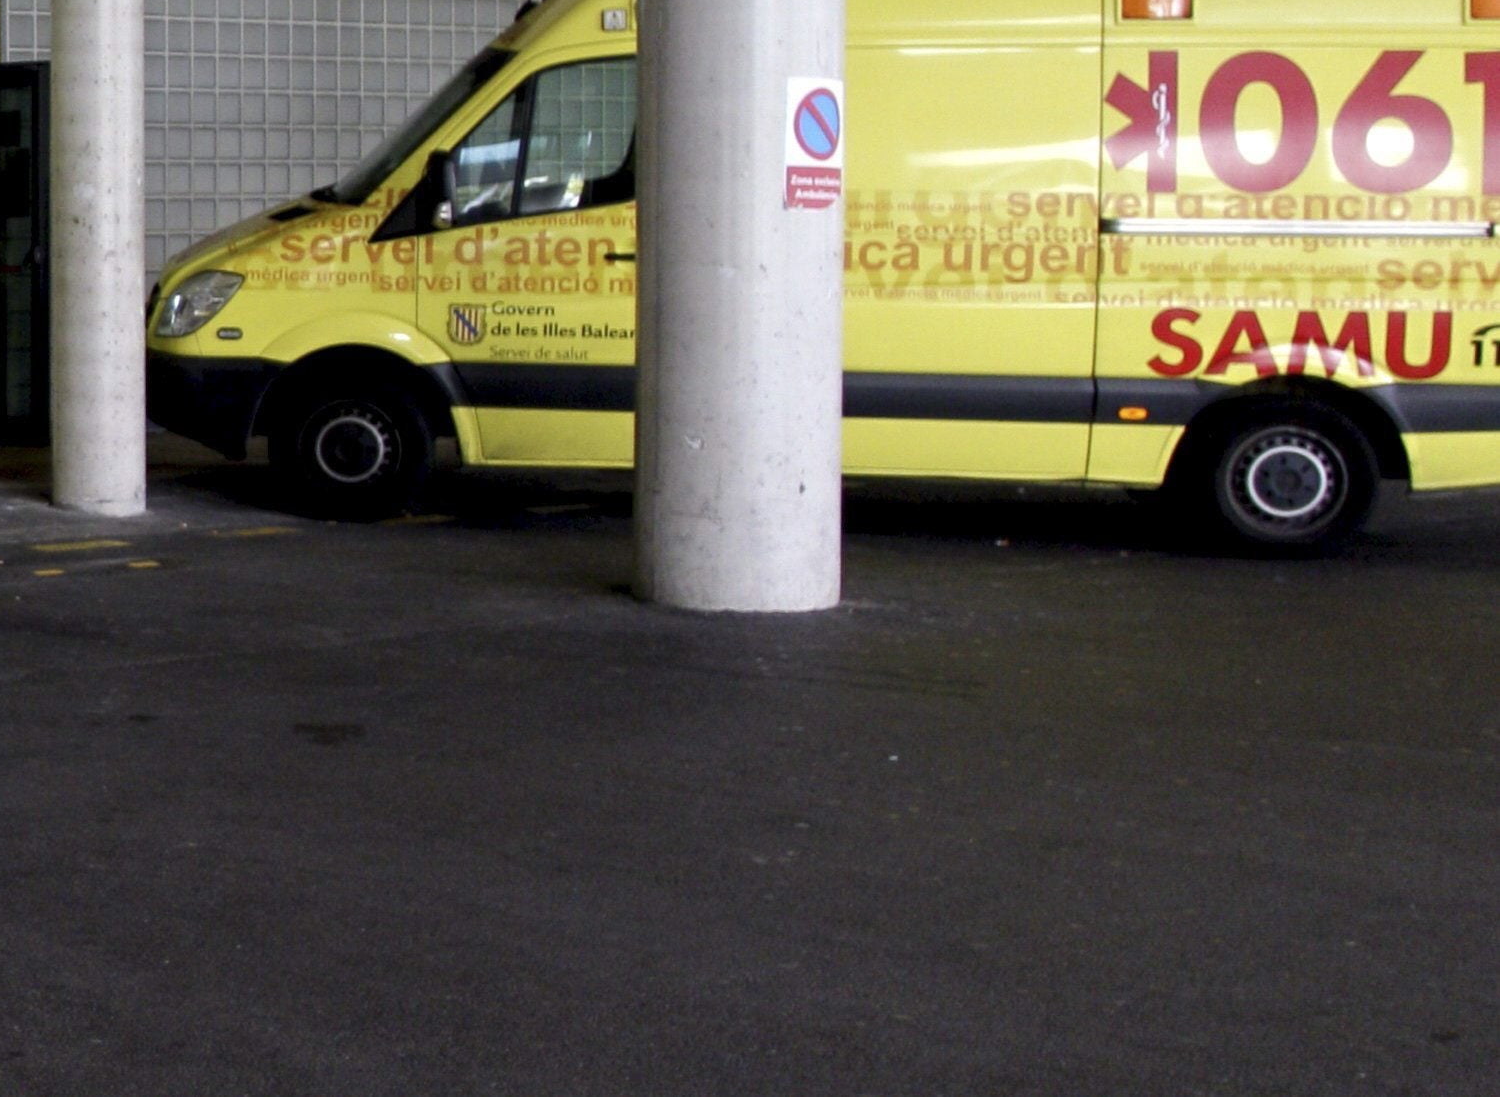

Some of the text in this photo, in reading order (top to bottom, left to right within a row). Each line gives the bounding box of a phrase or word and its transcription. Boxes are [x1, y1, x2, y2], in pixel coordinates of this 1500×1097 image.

[942, 234, 1131, 284] urgent
[379, 272, 461, 295] servei
[491, 300, 556, 317] Govern
[491, 323, 636, 340] de les Illes Balear
[1146, 307, 1453, 380] SAMU
